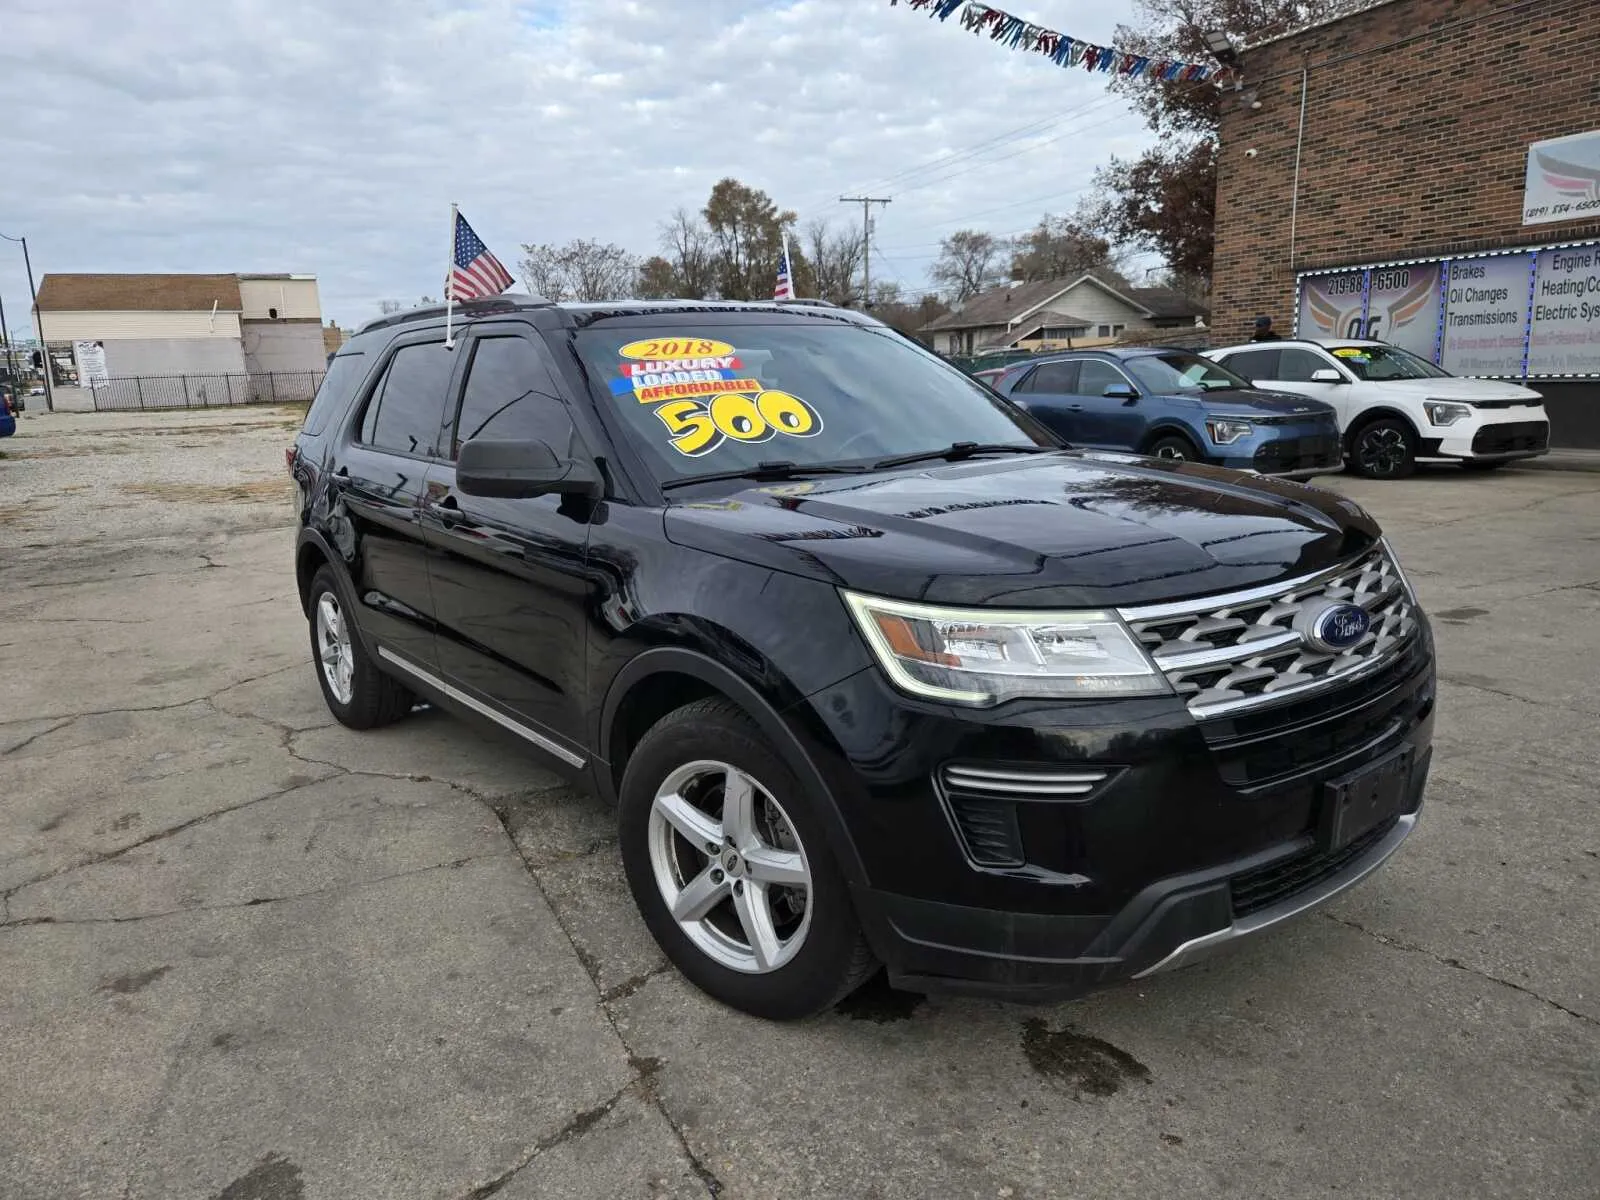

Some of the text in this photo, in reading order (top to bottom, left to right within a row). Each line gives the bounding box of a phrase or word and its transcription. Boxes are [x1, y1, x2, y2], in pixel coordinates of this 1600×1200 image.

[1553, 253, 1591, 273] Engine
[1452, 265, 1485, 281] Brakes
[1327, 271, 1409, 295] 219-88-6500
[1450, 288, 1508, 305] Oil Changes
[1448, 309, 1518, 327] Transmissions
[1536, 301, 1600, 322] Electric Sys
[643, 341, 713, 356] 2018
[631, 358, 735, 375] LUXURY
[632, 370, 722, 387] LOADED
[641, 380, 757, 400] AFFORDABLE
[654, 390, 823, 457] 500
